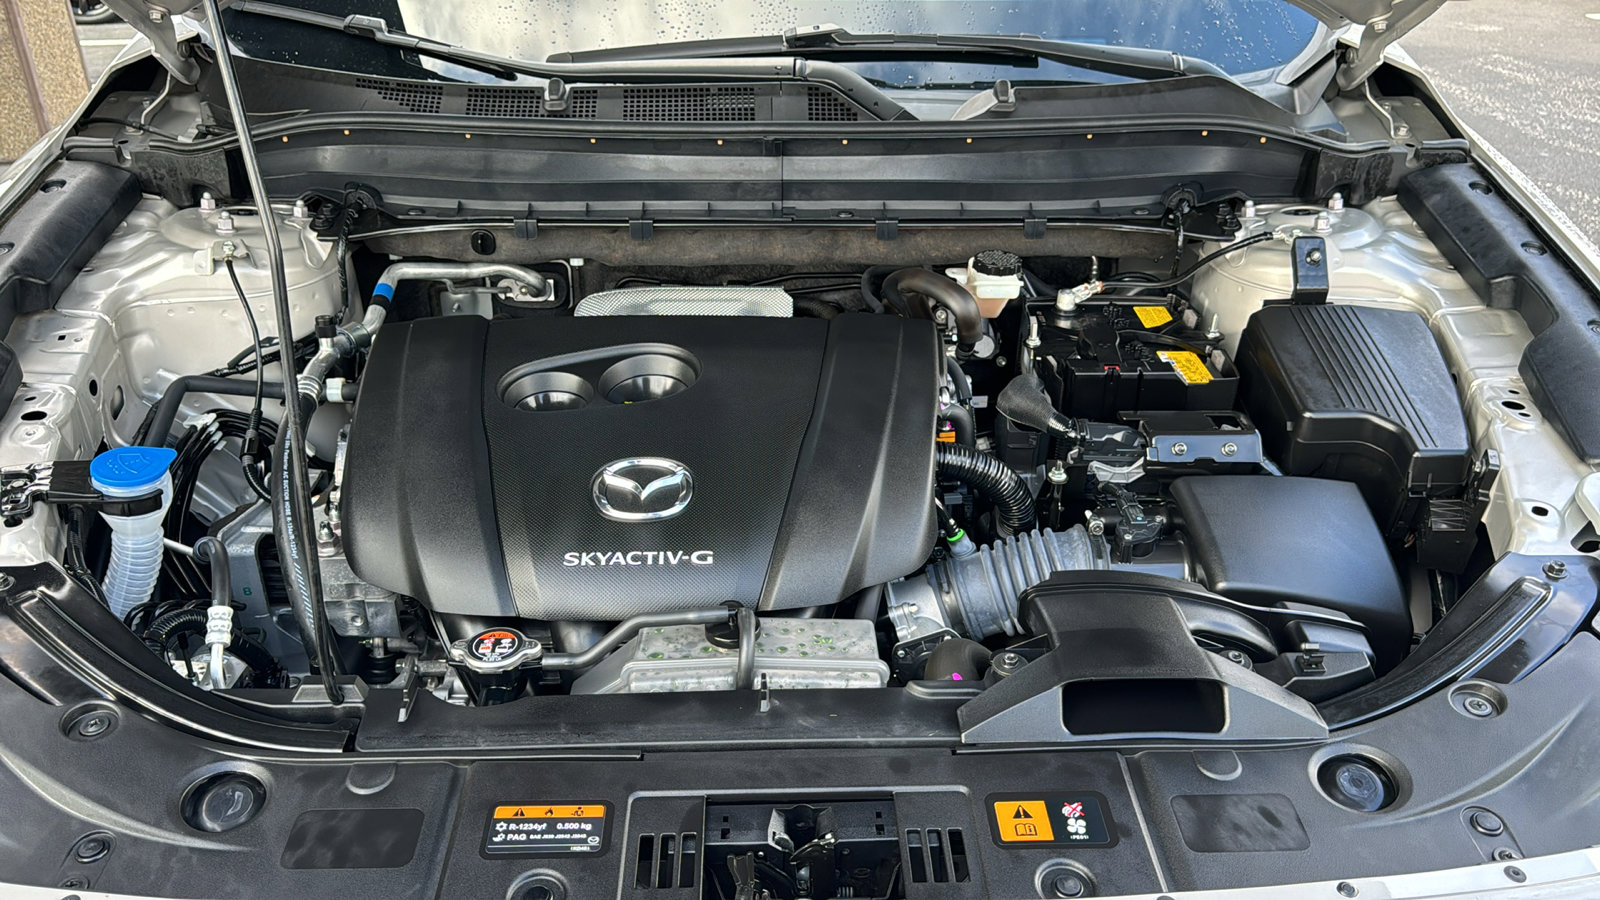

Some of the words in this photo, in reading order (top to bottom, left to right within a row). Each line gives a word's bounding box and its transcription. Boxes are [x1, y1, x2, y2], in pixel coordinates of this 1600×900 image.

[562, 550, 714, 566] SKYACTIV-G
[508, 823, 548, 832] R-1234yf
[580, 822, 592, 831] kg
